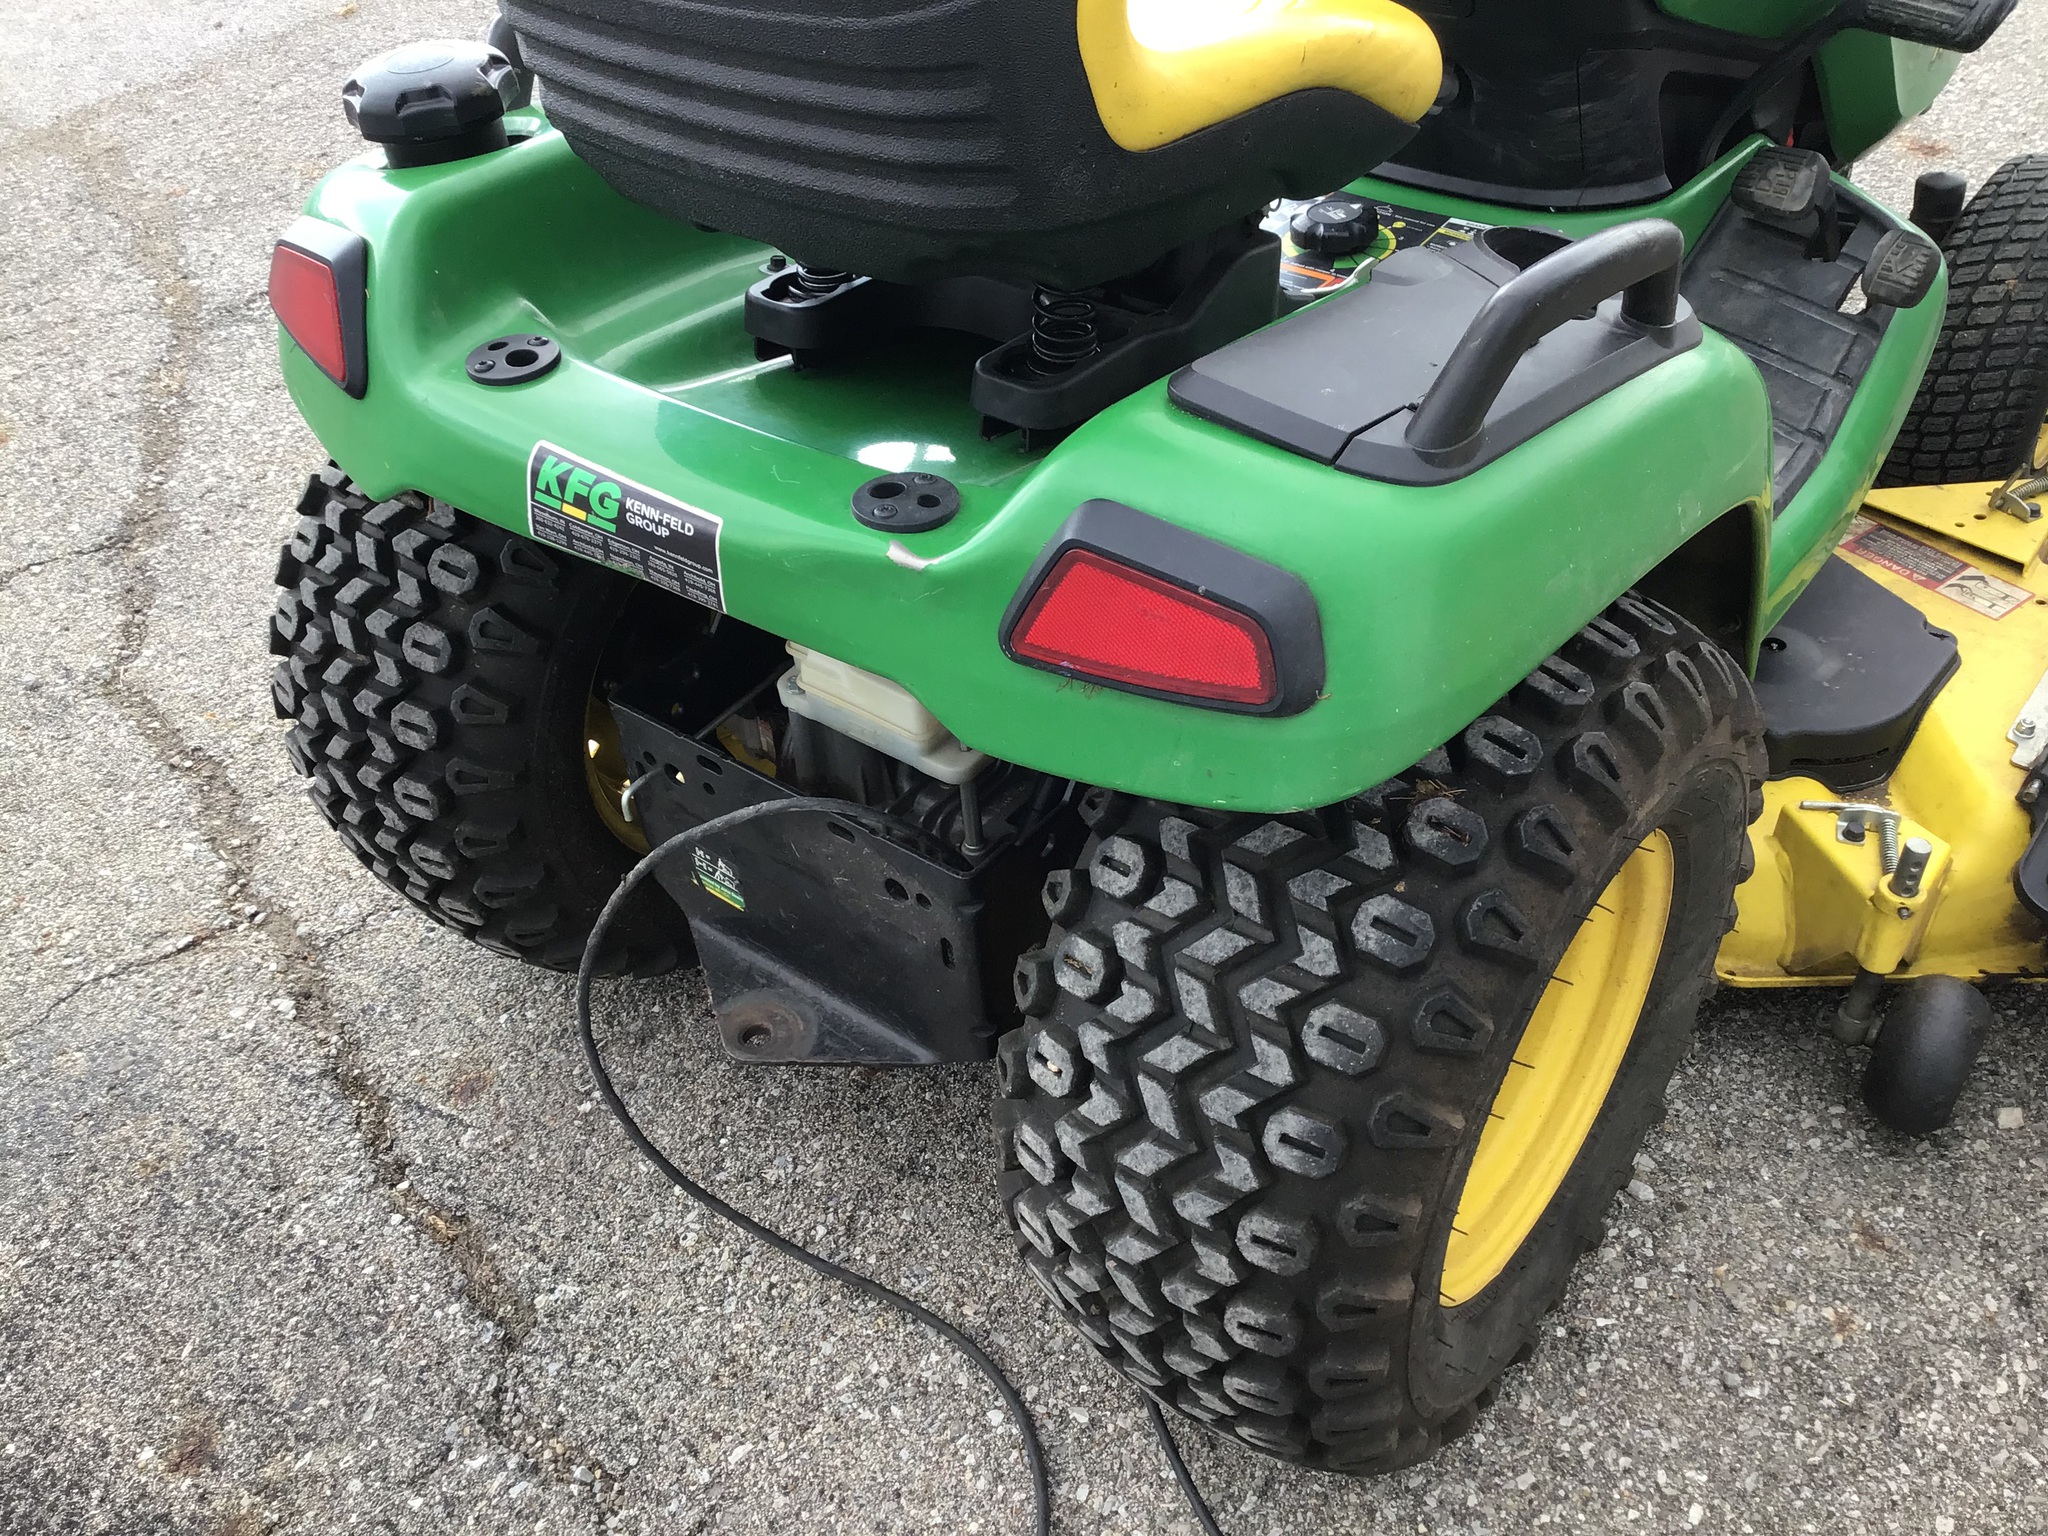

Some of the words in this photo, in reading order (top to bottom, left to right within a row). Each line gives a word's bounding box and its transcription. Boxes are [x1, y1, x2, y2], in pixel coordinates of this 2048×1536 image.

[536, 455, 622, 519] KFG
[625, 497, 695, 536] KENN-FELD
[625, 511, 670, 538] GROUP
[1855, 547, 1911, 575] DANGER
